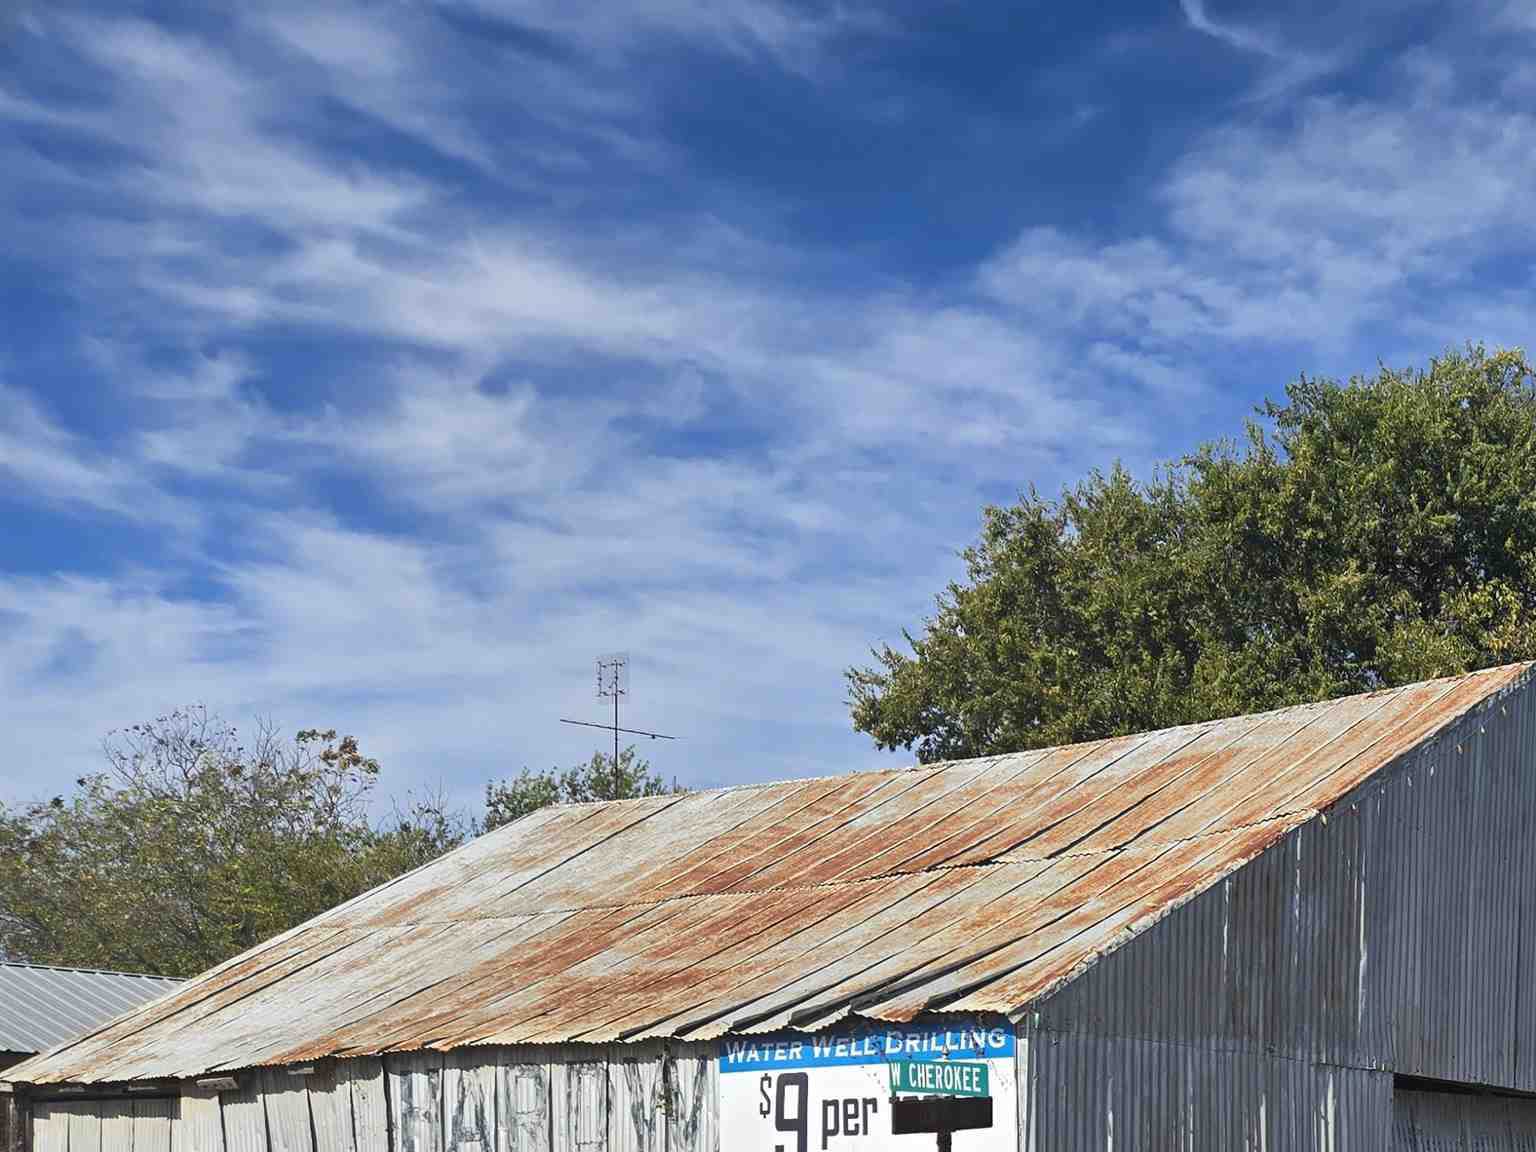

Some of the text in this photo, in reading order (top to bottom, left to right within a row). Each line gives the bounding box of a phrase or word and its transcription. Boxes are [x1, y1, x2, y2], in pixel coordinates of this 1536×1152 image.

[726, 1026, 1006, 1064] WATER WELL DRILLING
[890, 1062, 982, 1092] W CHEROKEE
[821, 1097, 878, 1150] per
